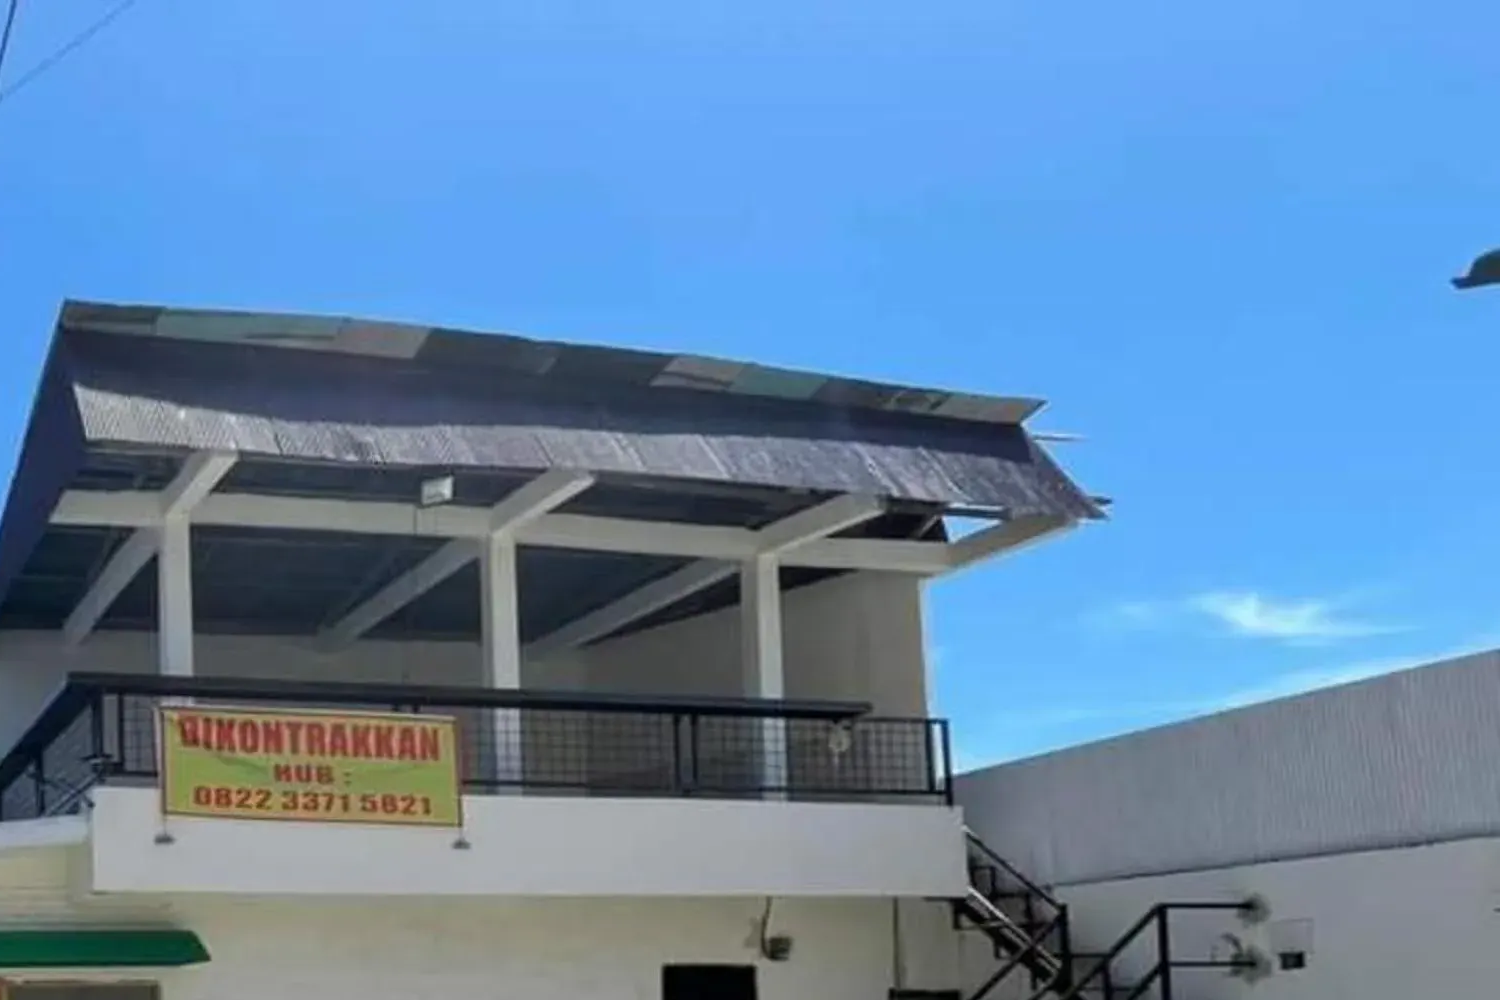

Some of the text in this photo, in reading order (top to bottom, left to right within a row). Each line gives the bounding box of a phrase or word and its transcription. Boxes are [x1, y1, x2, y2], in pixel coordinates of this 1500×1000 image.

[178, 716, 440, 761] DIKONTRAKKAN
[273, 764, 334, 784] HUB
[193, 785, 272, 811] 0822
[281, 790, 350, 813] 3371
